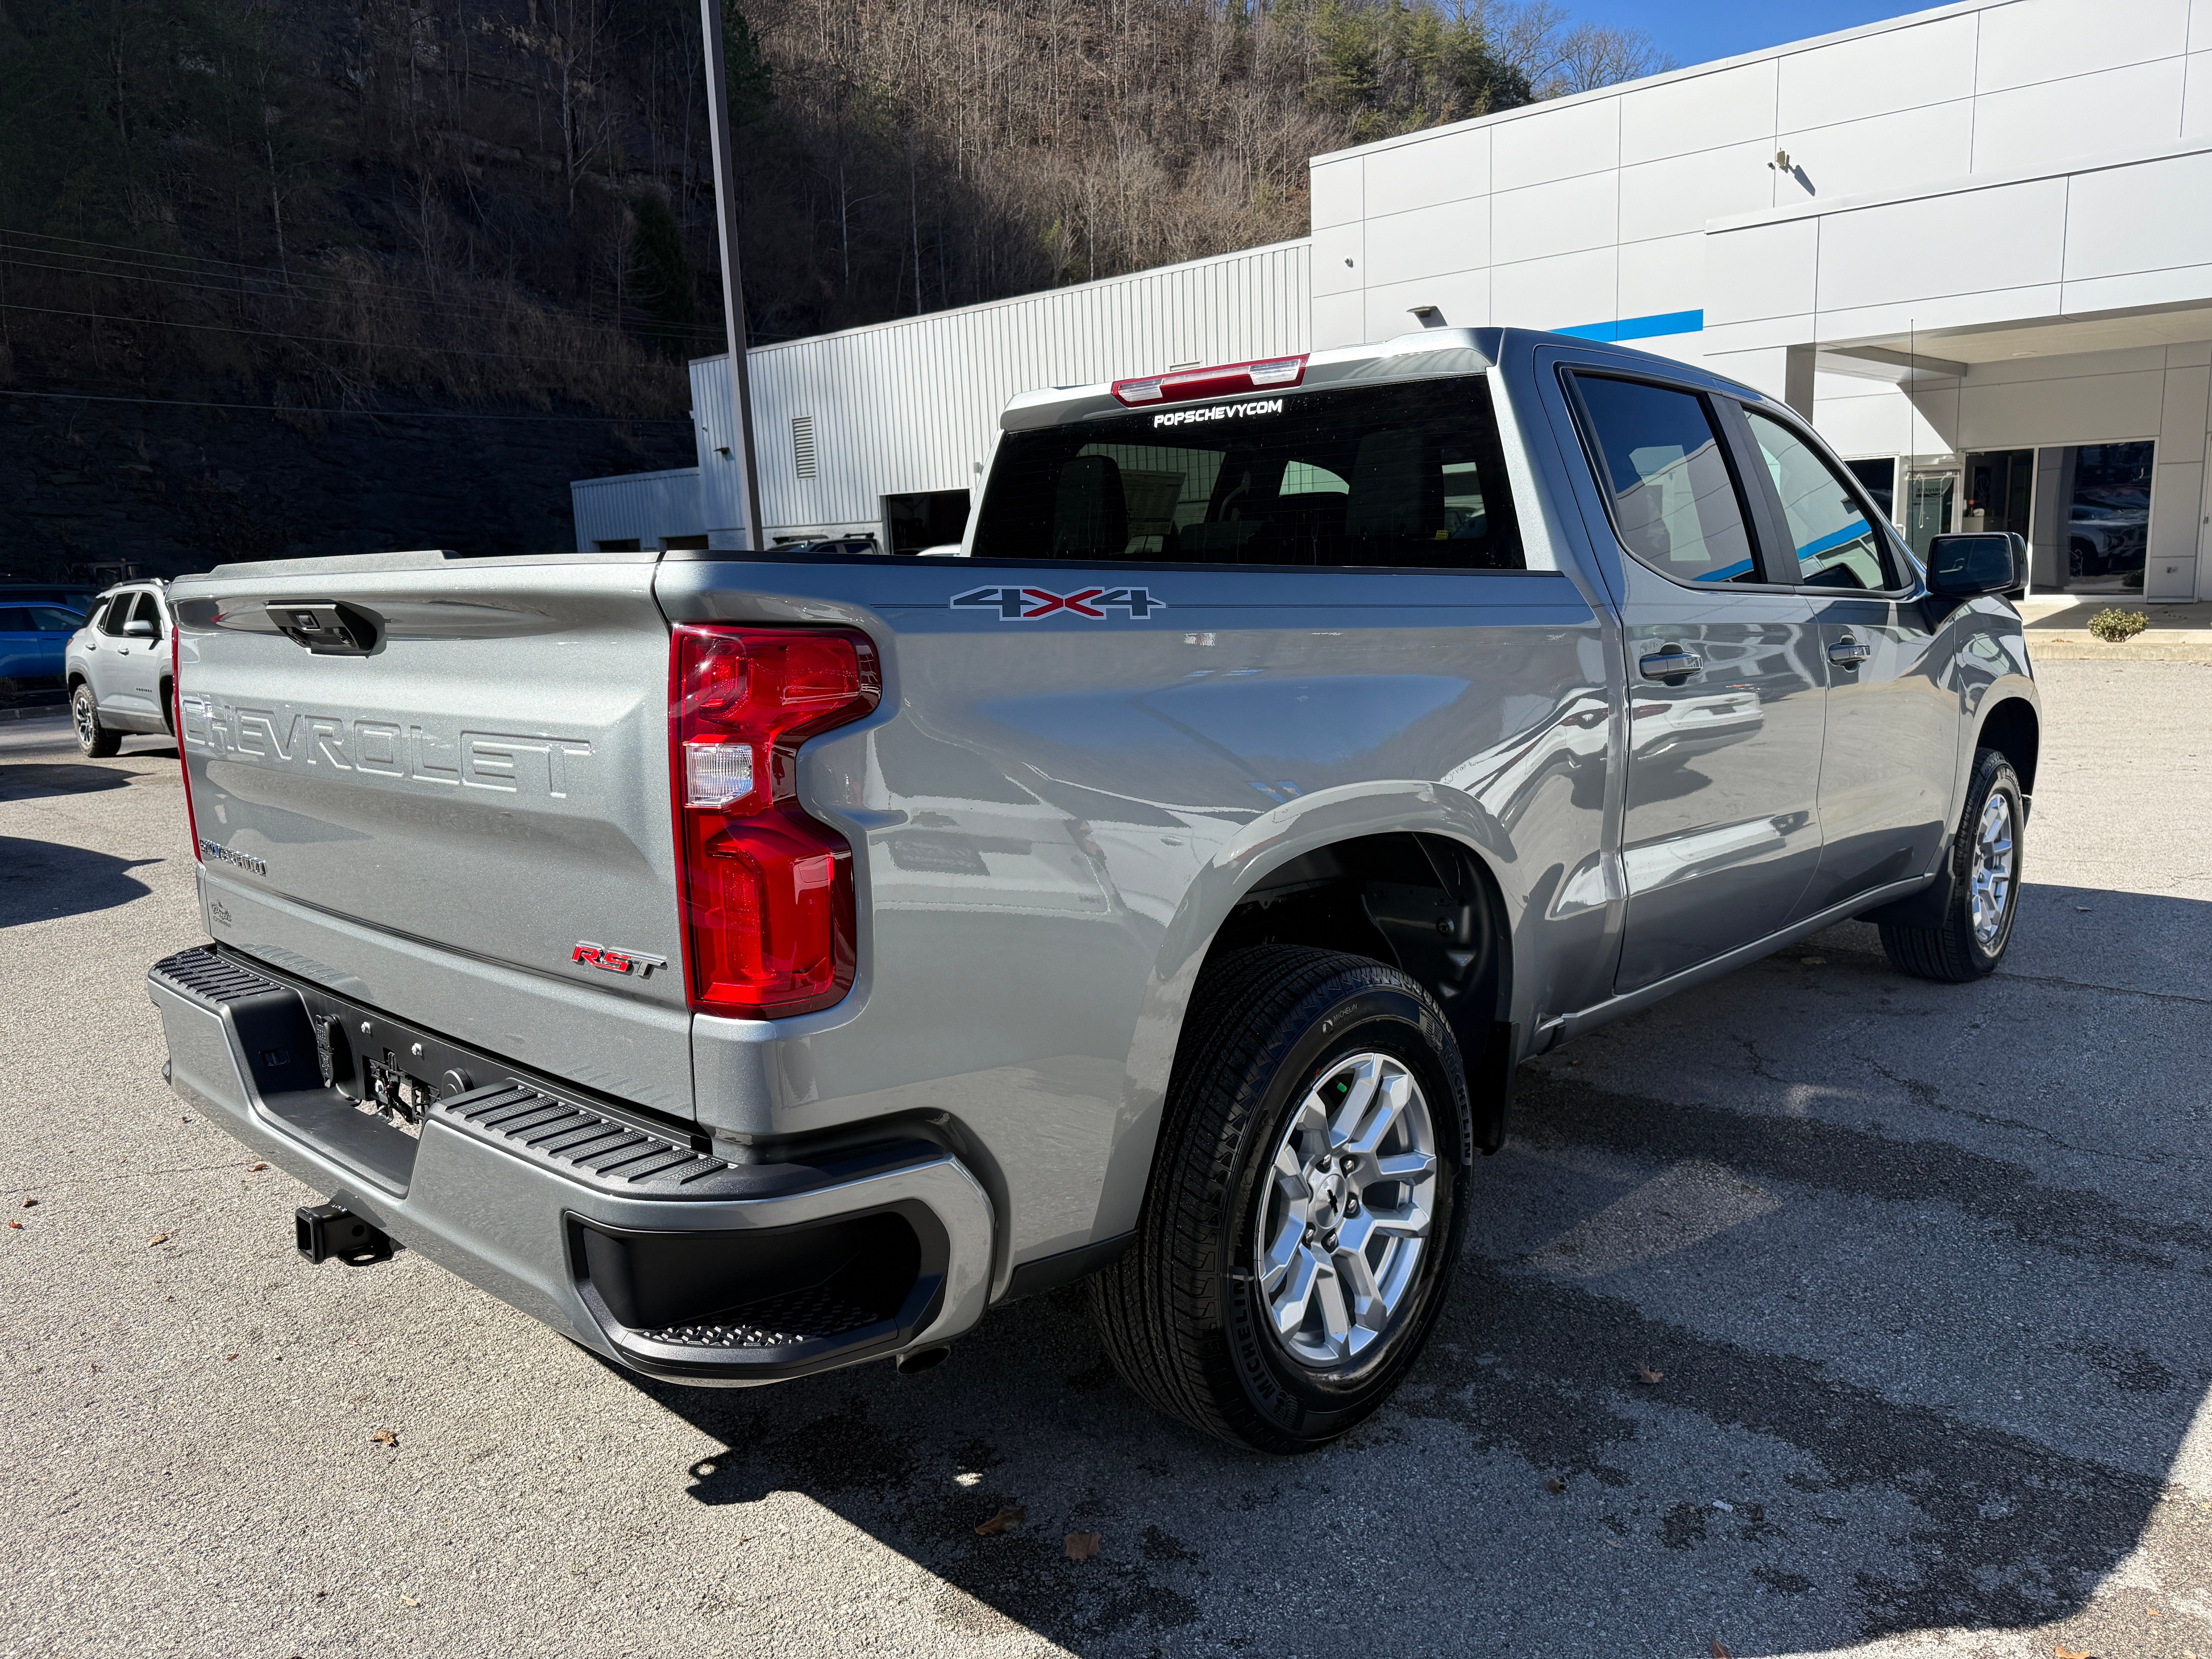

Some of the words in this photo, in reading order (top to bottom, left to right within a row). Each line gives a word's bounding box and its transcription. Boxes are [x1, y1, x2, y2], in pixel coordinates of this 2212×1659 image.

[1154, 399, 1283, 428] POPSCHEVYCOM
[182, 699, 595, 799] CHEVROLET
[571, 940, 667, 976] RST
[1333, 1003, 1357, 1022] MICHELIN
[1445, 1045, 1470, 1158] MICHELIN
[1233, 1279, 1276, 1400] MICHELIN
